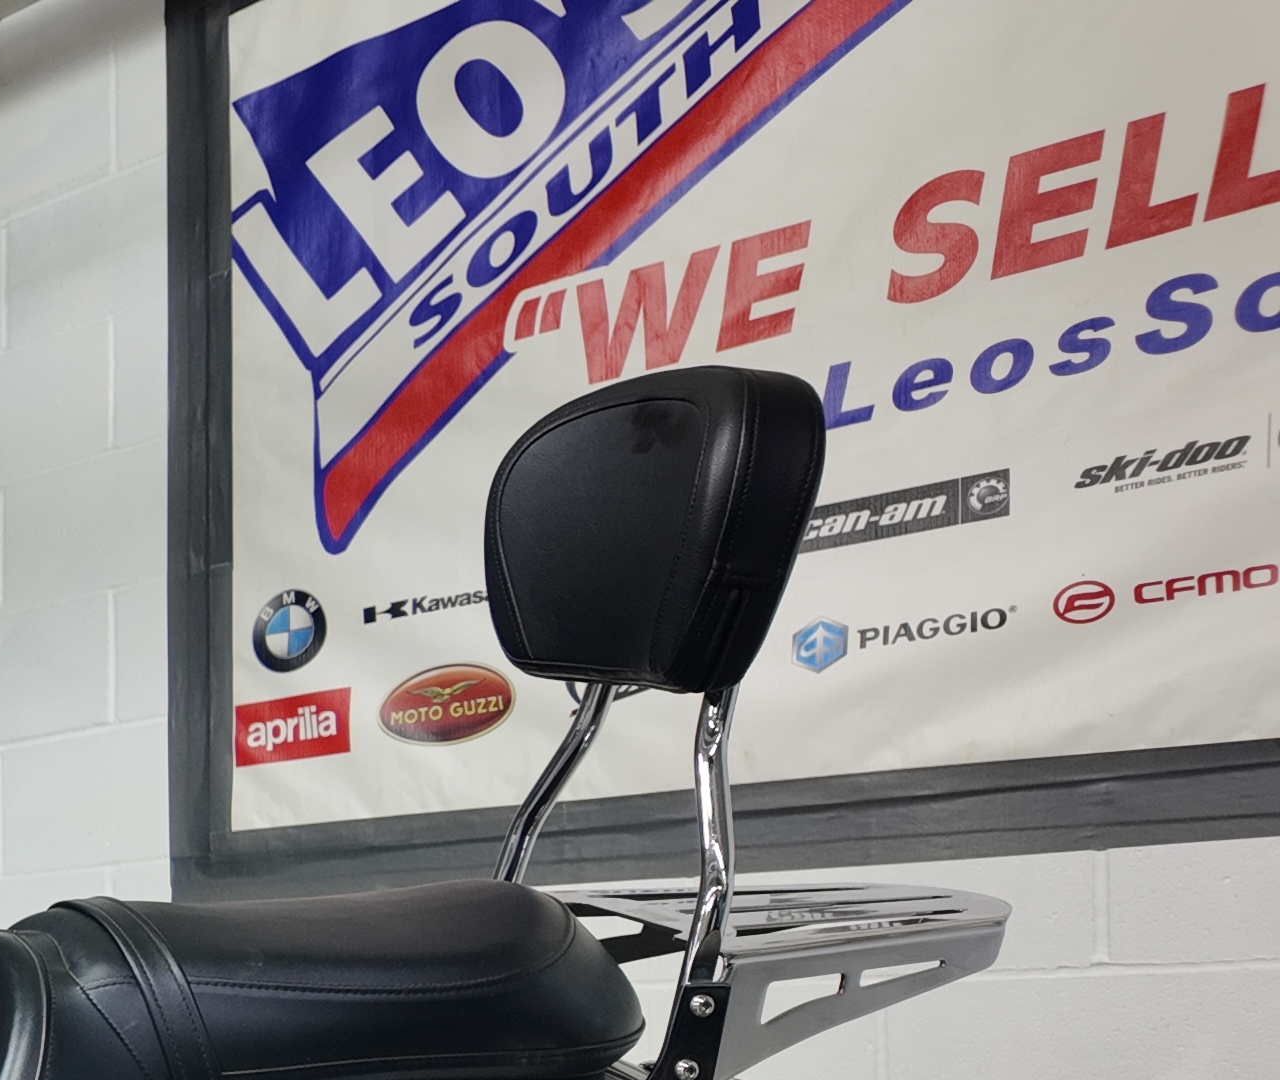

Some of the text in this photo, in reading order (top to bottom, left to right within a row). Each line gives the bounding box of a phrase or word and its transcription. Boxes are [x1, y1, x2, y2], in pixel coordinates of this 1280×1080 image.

[232, 0, 666, 358] LEO
[408, 0, 761, 349] SOUTH
[886, 82, 1280, 304] SELL
[1074, 435, 1251, 489] ski-doo
[1114, 481, 1145, 493] BETTER
[1147, 475, 1175, 487] RIDES.
[1176, 468, 1208, 481] BETTER
[803, 495, 947, 541] can-am
[260, 591, 320, 621] BMW
[1134, 564, 1279, 604] CFMO
[857, 607, 1008, 649] PIAGGIO
[247, 706, 338, 751] aprilia
[390, 695, 504, 726] MOTO GUZZI
